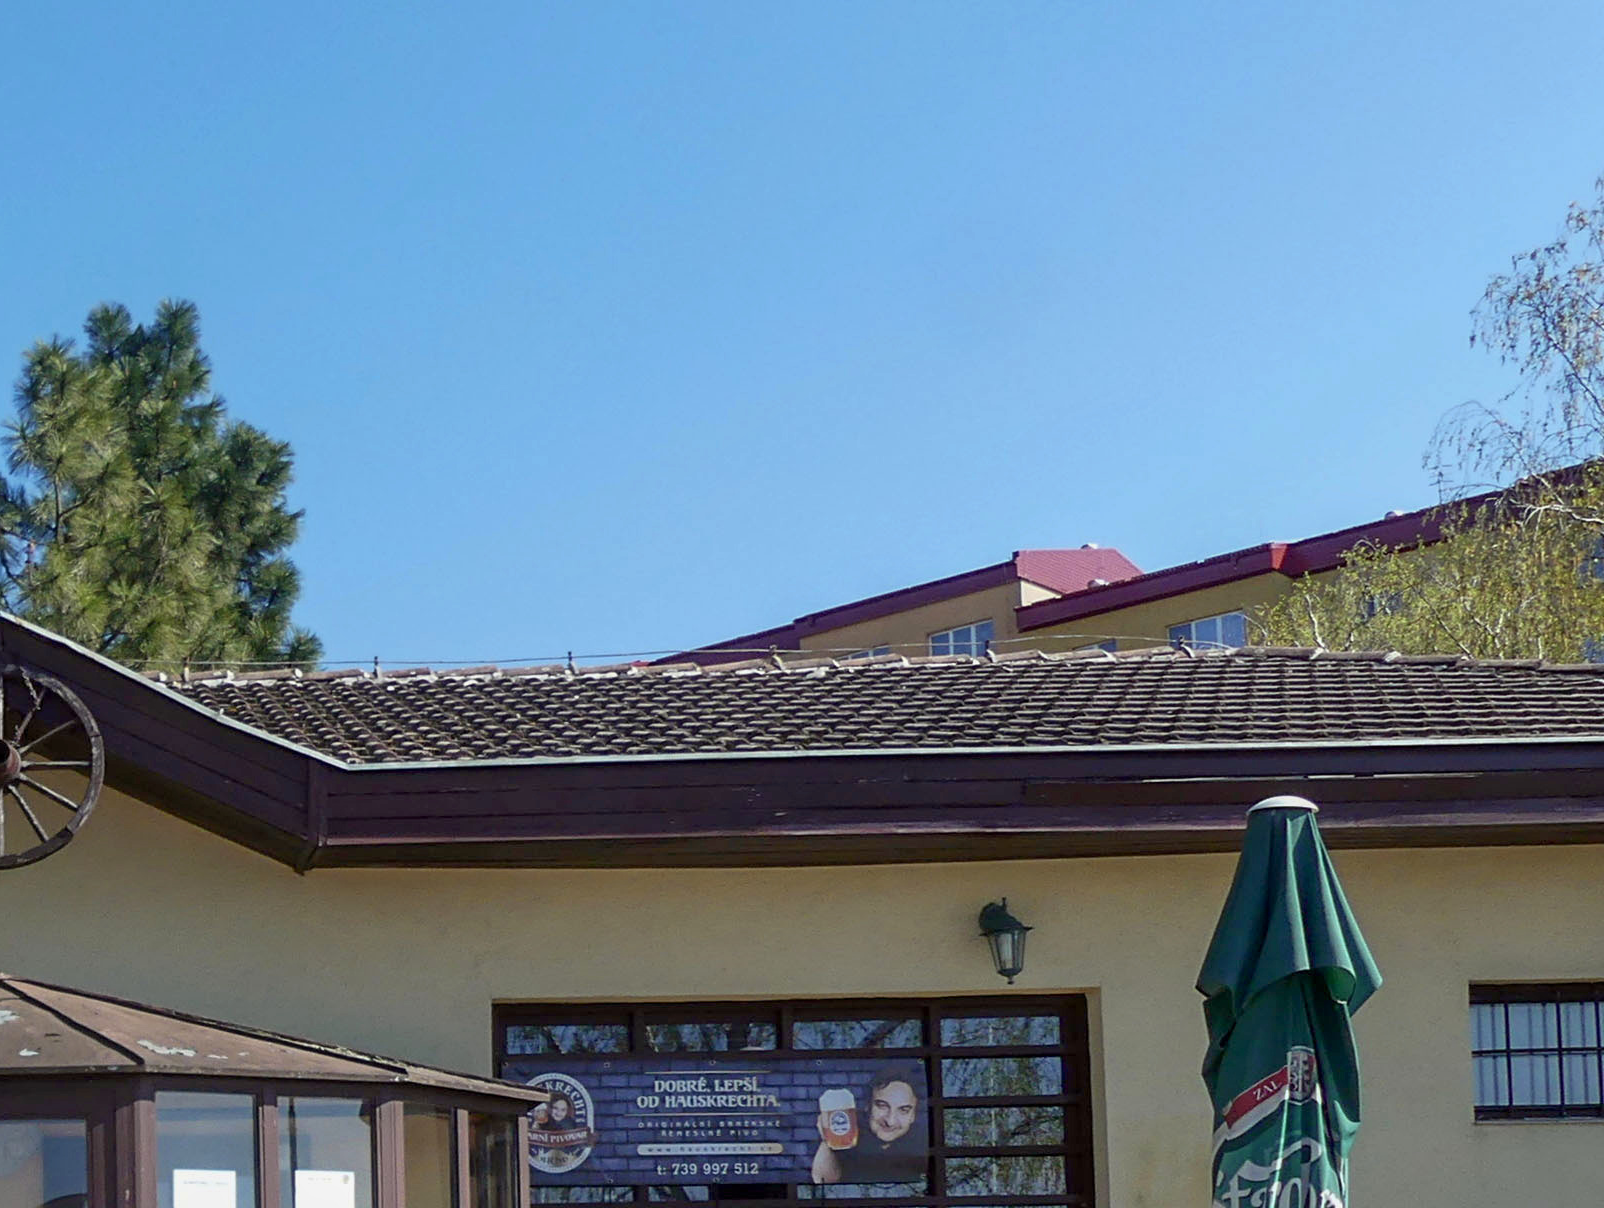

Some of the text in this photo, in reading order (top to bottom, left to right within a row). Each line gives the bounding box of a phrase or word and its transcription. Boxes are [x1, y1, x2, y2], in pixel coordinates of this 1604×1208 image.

[654, 1076, 711, 1093] DOBRÉ.
[636, 1094, 781, 1109] OD HAUSKRECHTA.
[656, 1162, 760, 1176] t: 739 997 512
